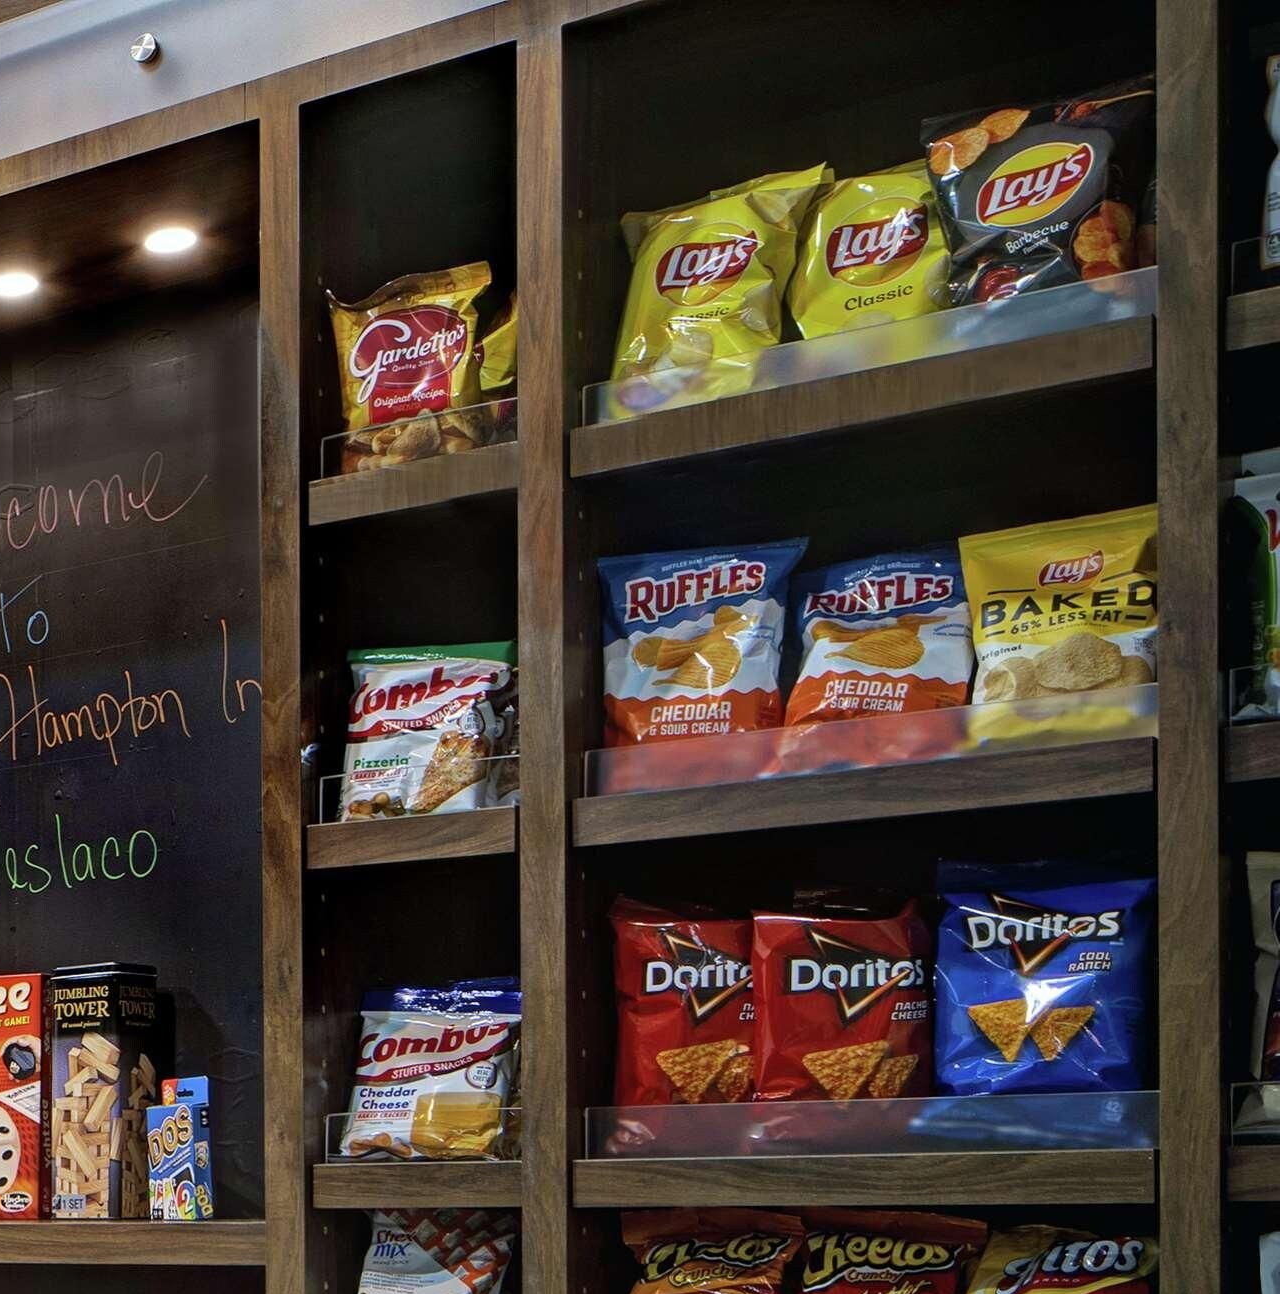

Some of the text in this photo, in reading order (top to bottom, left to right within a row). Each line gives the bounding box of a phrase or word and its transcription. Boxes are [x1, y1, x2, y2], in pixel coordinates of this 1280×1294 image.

[984, 150, 1087, 218] Lay's
[1005, 219, 1070, 255] Barbecue
[844, 282, 914, 312] Classic
[349, 319, 465, 404] Gardetto's
[373, 392, 412, 408] Original
[411, 389, 445, 402] Recipe
[1042, 552, 1103, 584] Lay's
[625, 560, 767, 623] RUFFLES
[805, 573, 953, 618] RUFFLES
[980, 580, 1157, 630] BAKED
[1009, 609, 1123, 636] 65% LESS FAT
[824, 679, 909, 700] CHEDDAR
[650, 701, 732, 724] CHEDDAR
[829, 696, 904, 713] SOUR CREAM
[659, 723, 689, 736] SOUR
[690, 721, 730, 736] CREAM
[353, 754, 409, 770] Pizzeria
[966, 910, 1121, 950] Doritos
[1067, 960, 1112, 973] RANCH
[1078, 951, 1112, 962] COOL
[791, 958, 924, 993] Doritos
[54, 985, 110, 1003] JUMBLING
[894, 999, 929, 1011] NACHO
[54, 1000, 110, 1020] TOWER
[119, 1000, 156, 1019] TOWER
[891, 1009, 927, 1021] CHEESE
[3, 1016, 31, 1028] GAME!
[356, 1022, 509, 1068] Combos
[391, 1055, 474, 1080] STUFFED SNACKS
[359, 1086, 418, 1099] Cheddar
[361, 1099, 410, 1111] Cheese
[147, 1106, 194, 1170] DOS
[68, 1198, 84, 1209] SET
[802, 1232, 950, 1292] Cheetos
[668, 1263, 742, 1287] Crunchy
[844, 1268, 905, 1285] Crunchy
